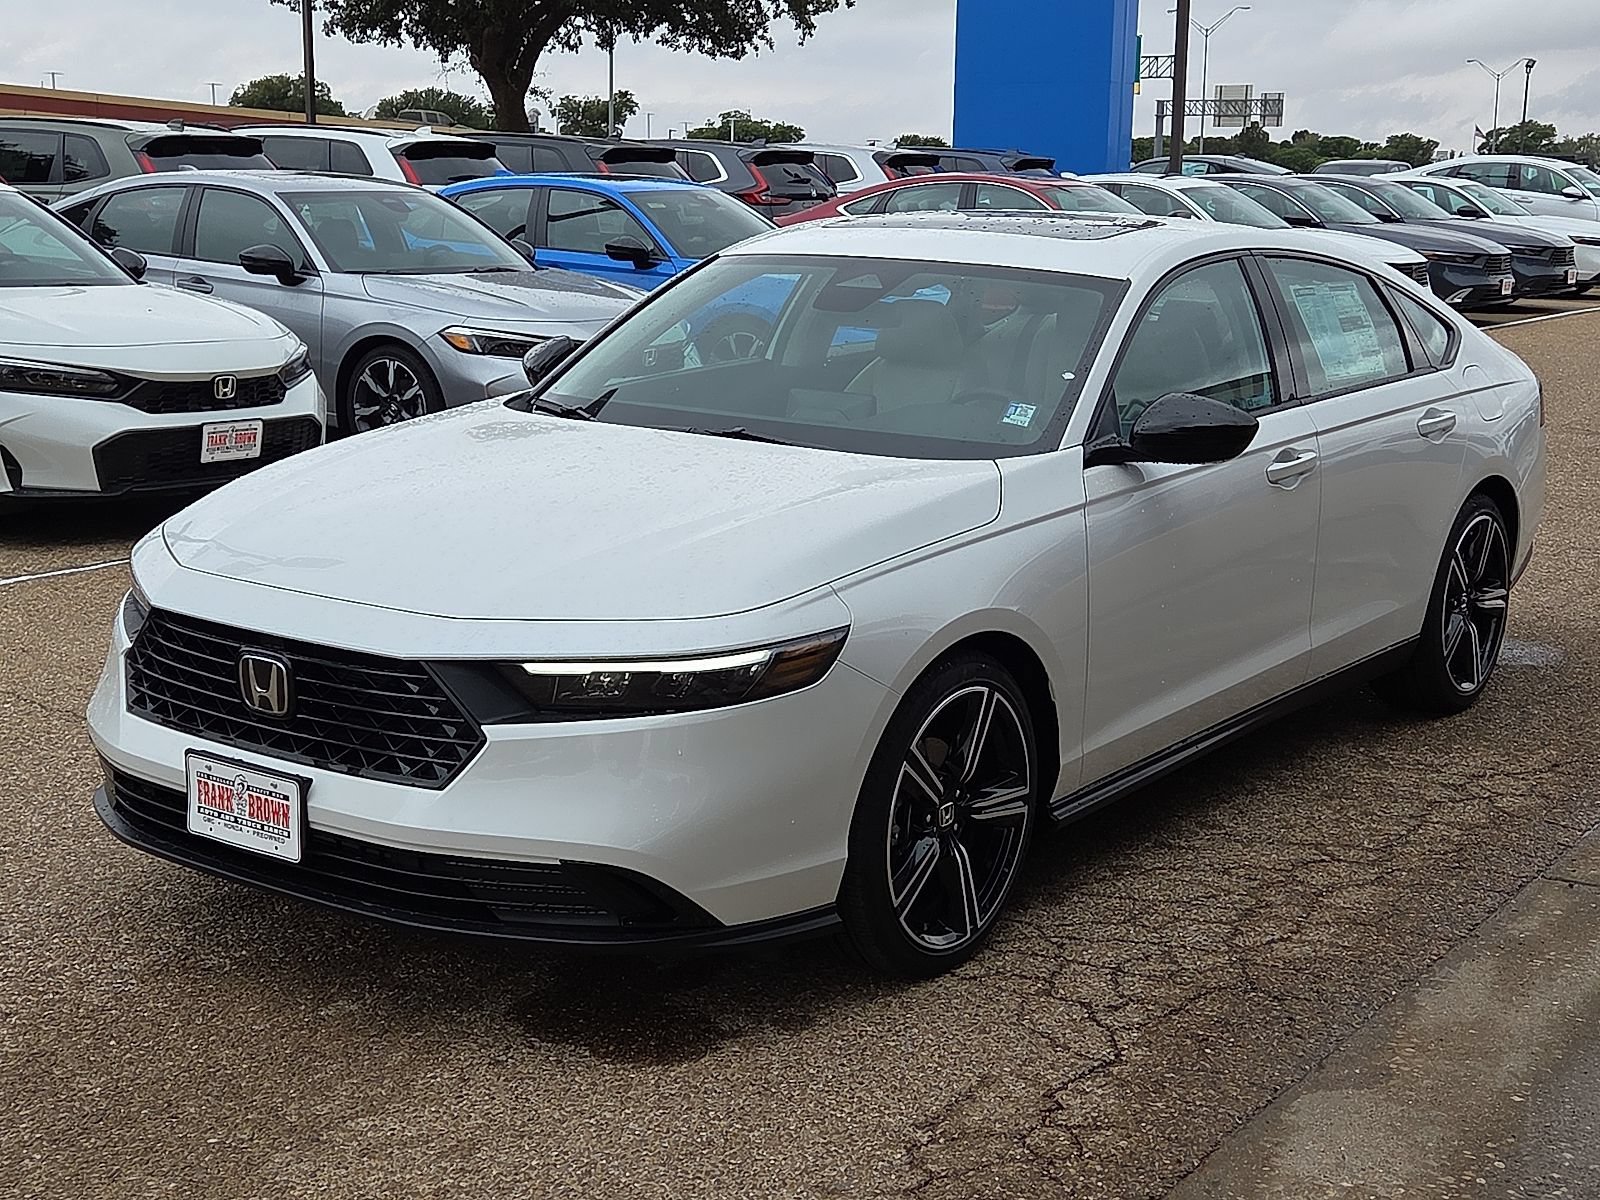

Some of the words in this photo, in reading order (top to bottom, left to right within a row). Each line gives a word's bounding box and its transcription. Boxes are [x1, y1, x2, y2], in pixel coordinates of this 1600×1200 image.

[197, 779, 234, 814] FRANK
[247, 793, 290, 830] BROWN
[200, 807, 219, 817] AUTO
[220, 813, 235, 822] AND
[236, 818, 261, 830] TRUCK
[263, 825, 289, 837] RANCH
[203, 815, 215, 825] GMC
[223, 822, 244, 833] HONDA
[252, 830, 286, 844] PREOWNED
